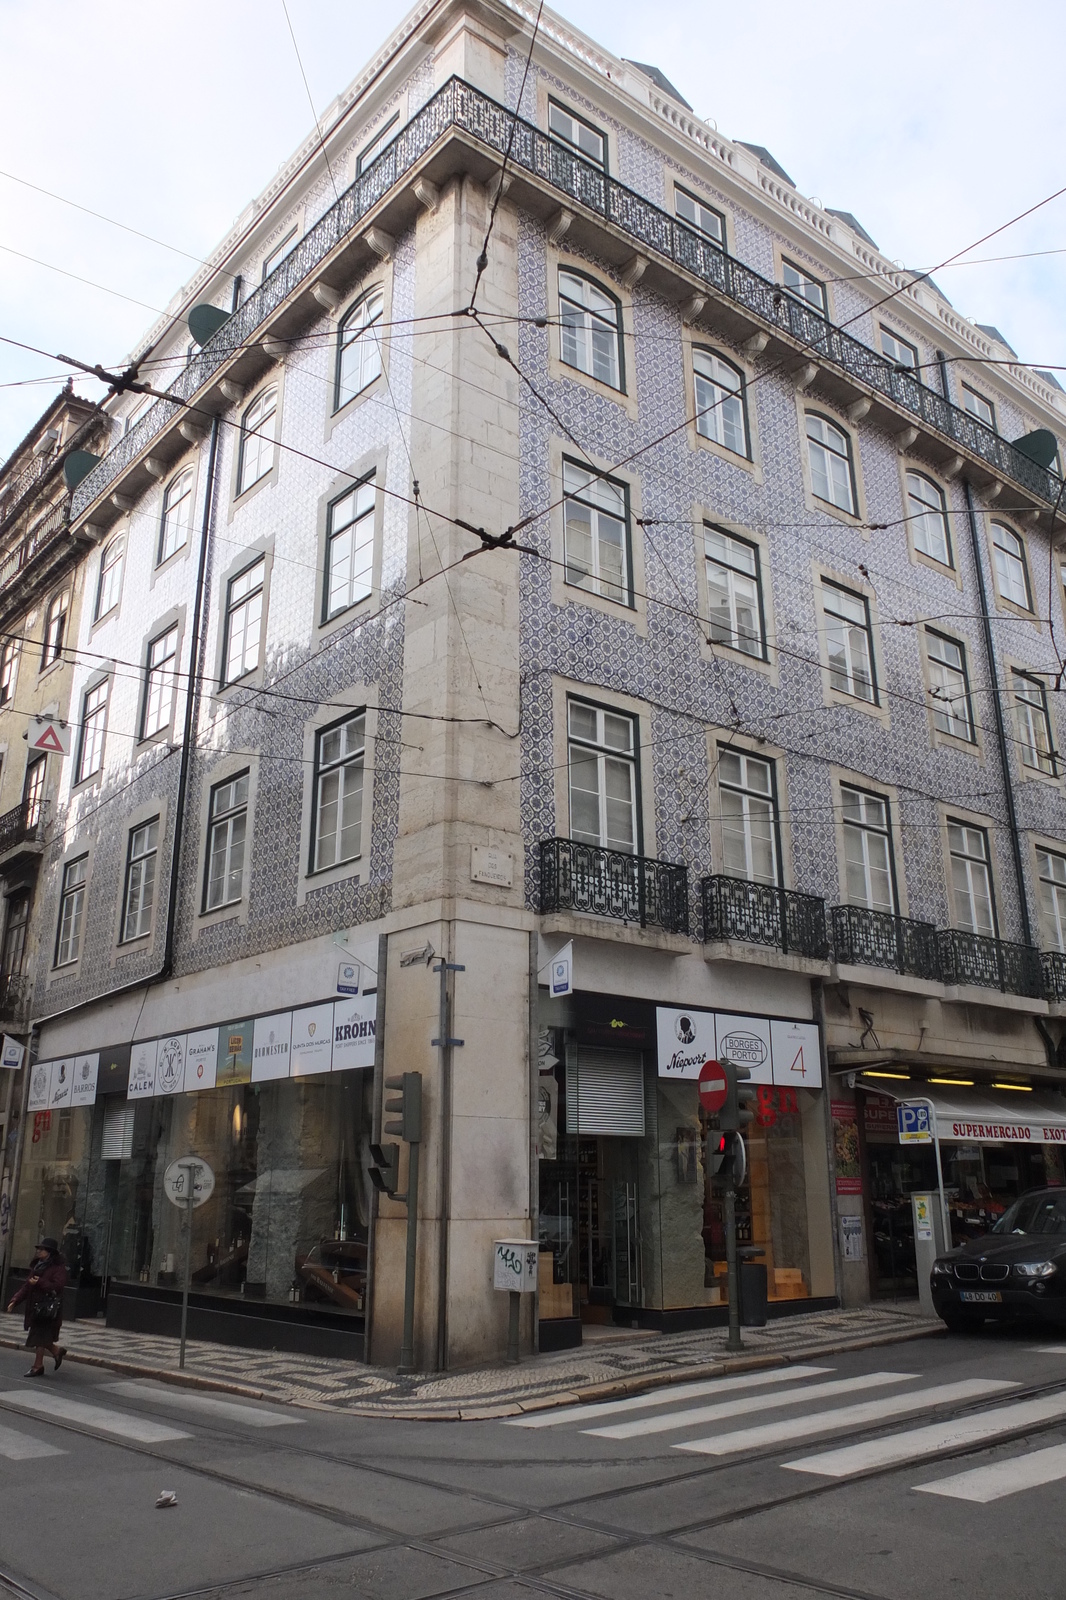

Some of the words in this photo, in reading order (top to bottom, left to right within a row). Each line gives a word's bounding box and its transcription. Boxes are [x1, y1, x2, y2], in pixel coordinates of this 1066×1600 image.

[335, 1019, 376, 1042] KROHN
[189, 1044, 215, 1056] GRAHAM'S
[729, 1039, 759, 1050] BORGES
[666, 1050, 707, 1073] Niepoort
[732, 1050, 758, 1061] PORTO
[74, 1082, 96, 1094] BARROS
[901, 1108, 916, 1132] P
[953, 1123, 1031, 1140] SUPERMERCADO
